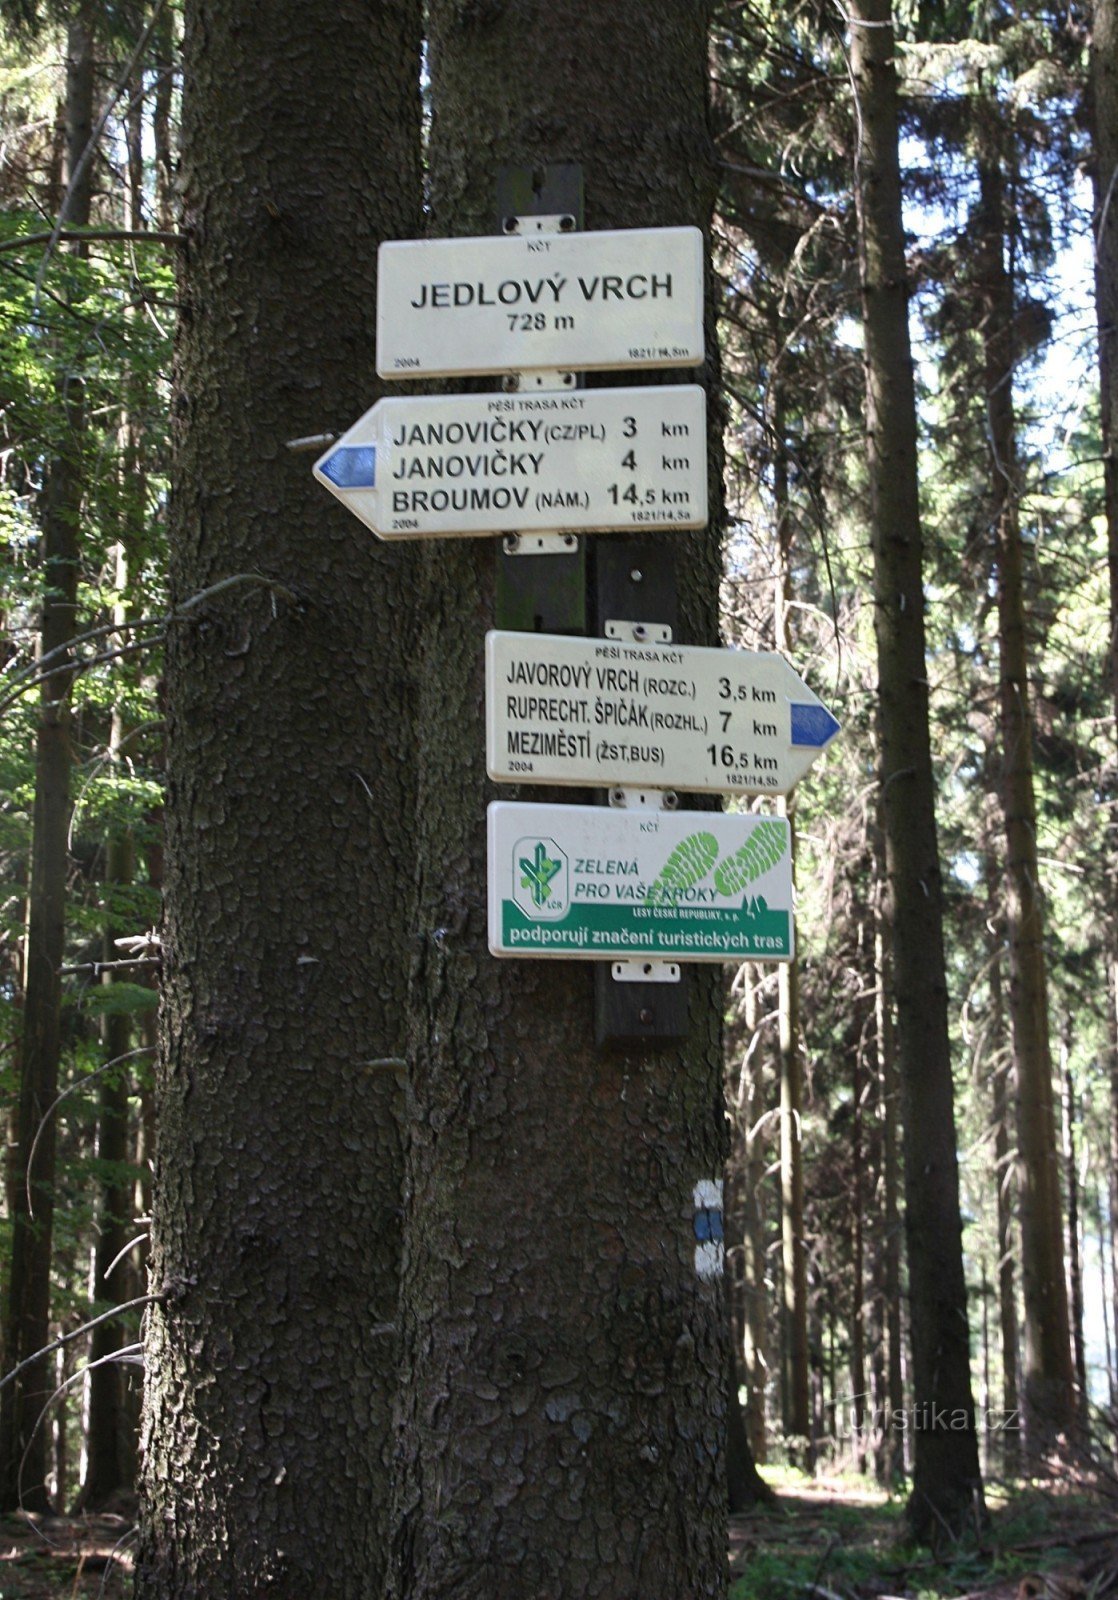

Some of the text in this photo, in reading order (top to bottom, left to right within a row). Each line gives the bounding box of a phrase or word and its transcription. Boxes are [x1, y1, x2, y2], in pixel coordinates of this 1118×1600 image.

[410, 272, 673, 309] JEDLOVÝ VRCH
[506, 313, 575, 331] 728 m
[517, 400, 559, 411] TRASA
[562, 398, 585, 410] KČT
[392, 416, 544, 447] JANOVIČKY
[622, 416, 638, 438] 3
[661, 421, 690, 438] km
[392, 449, 690, 480] JANOVIČKY 4 km
[392, 483, 690, 513] BROUMOV (NÁM.) 14,5 km
[623, 649, 660, 662] TRASA
[662, 652, 684, 665] KČT
[506, 660, 776, 702] JAVOROVÝ VRCH (ROZC.) 3,5 km
[507, 696, 777, 737] RUPRECHT. ŠPIČÁK (ROZHL.) 7 km
[507, 730, 778, 771] MEZIMĚSTÍ (ŽST,BUS) 16,5 km
[508, 761, 534, 772] 2004
[639, 821, 660, 832] KČT
[574, 857, 639, 876] ZELENÁ
[574, 882, 719, 903] PRO VAŠE KROKY
[632, 907, 651, 918] LESY
[510, 926, 784, 950] podporují značení turistických tras
